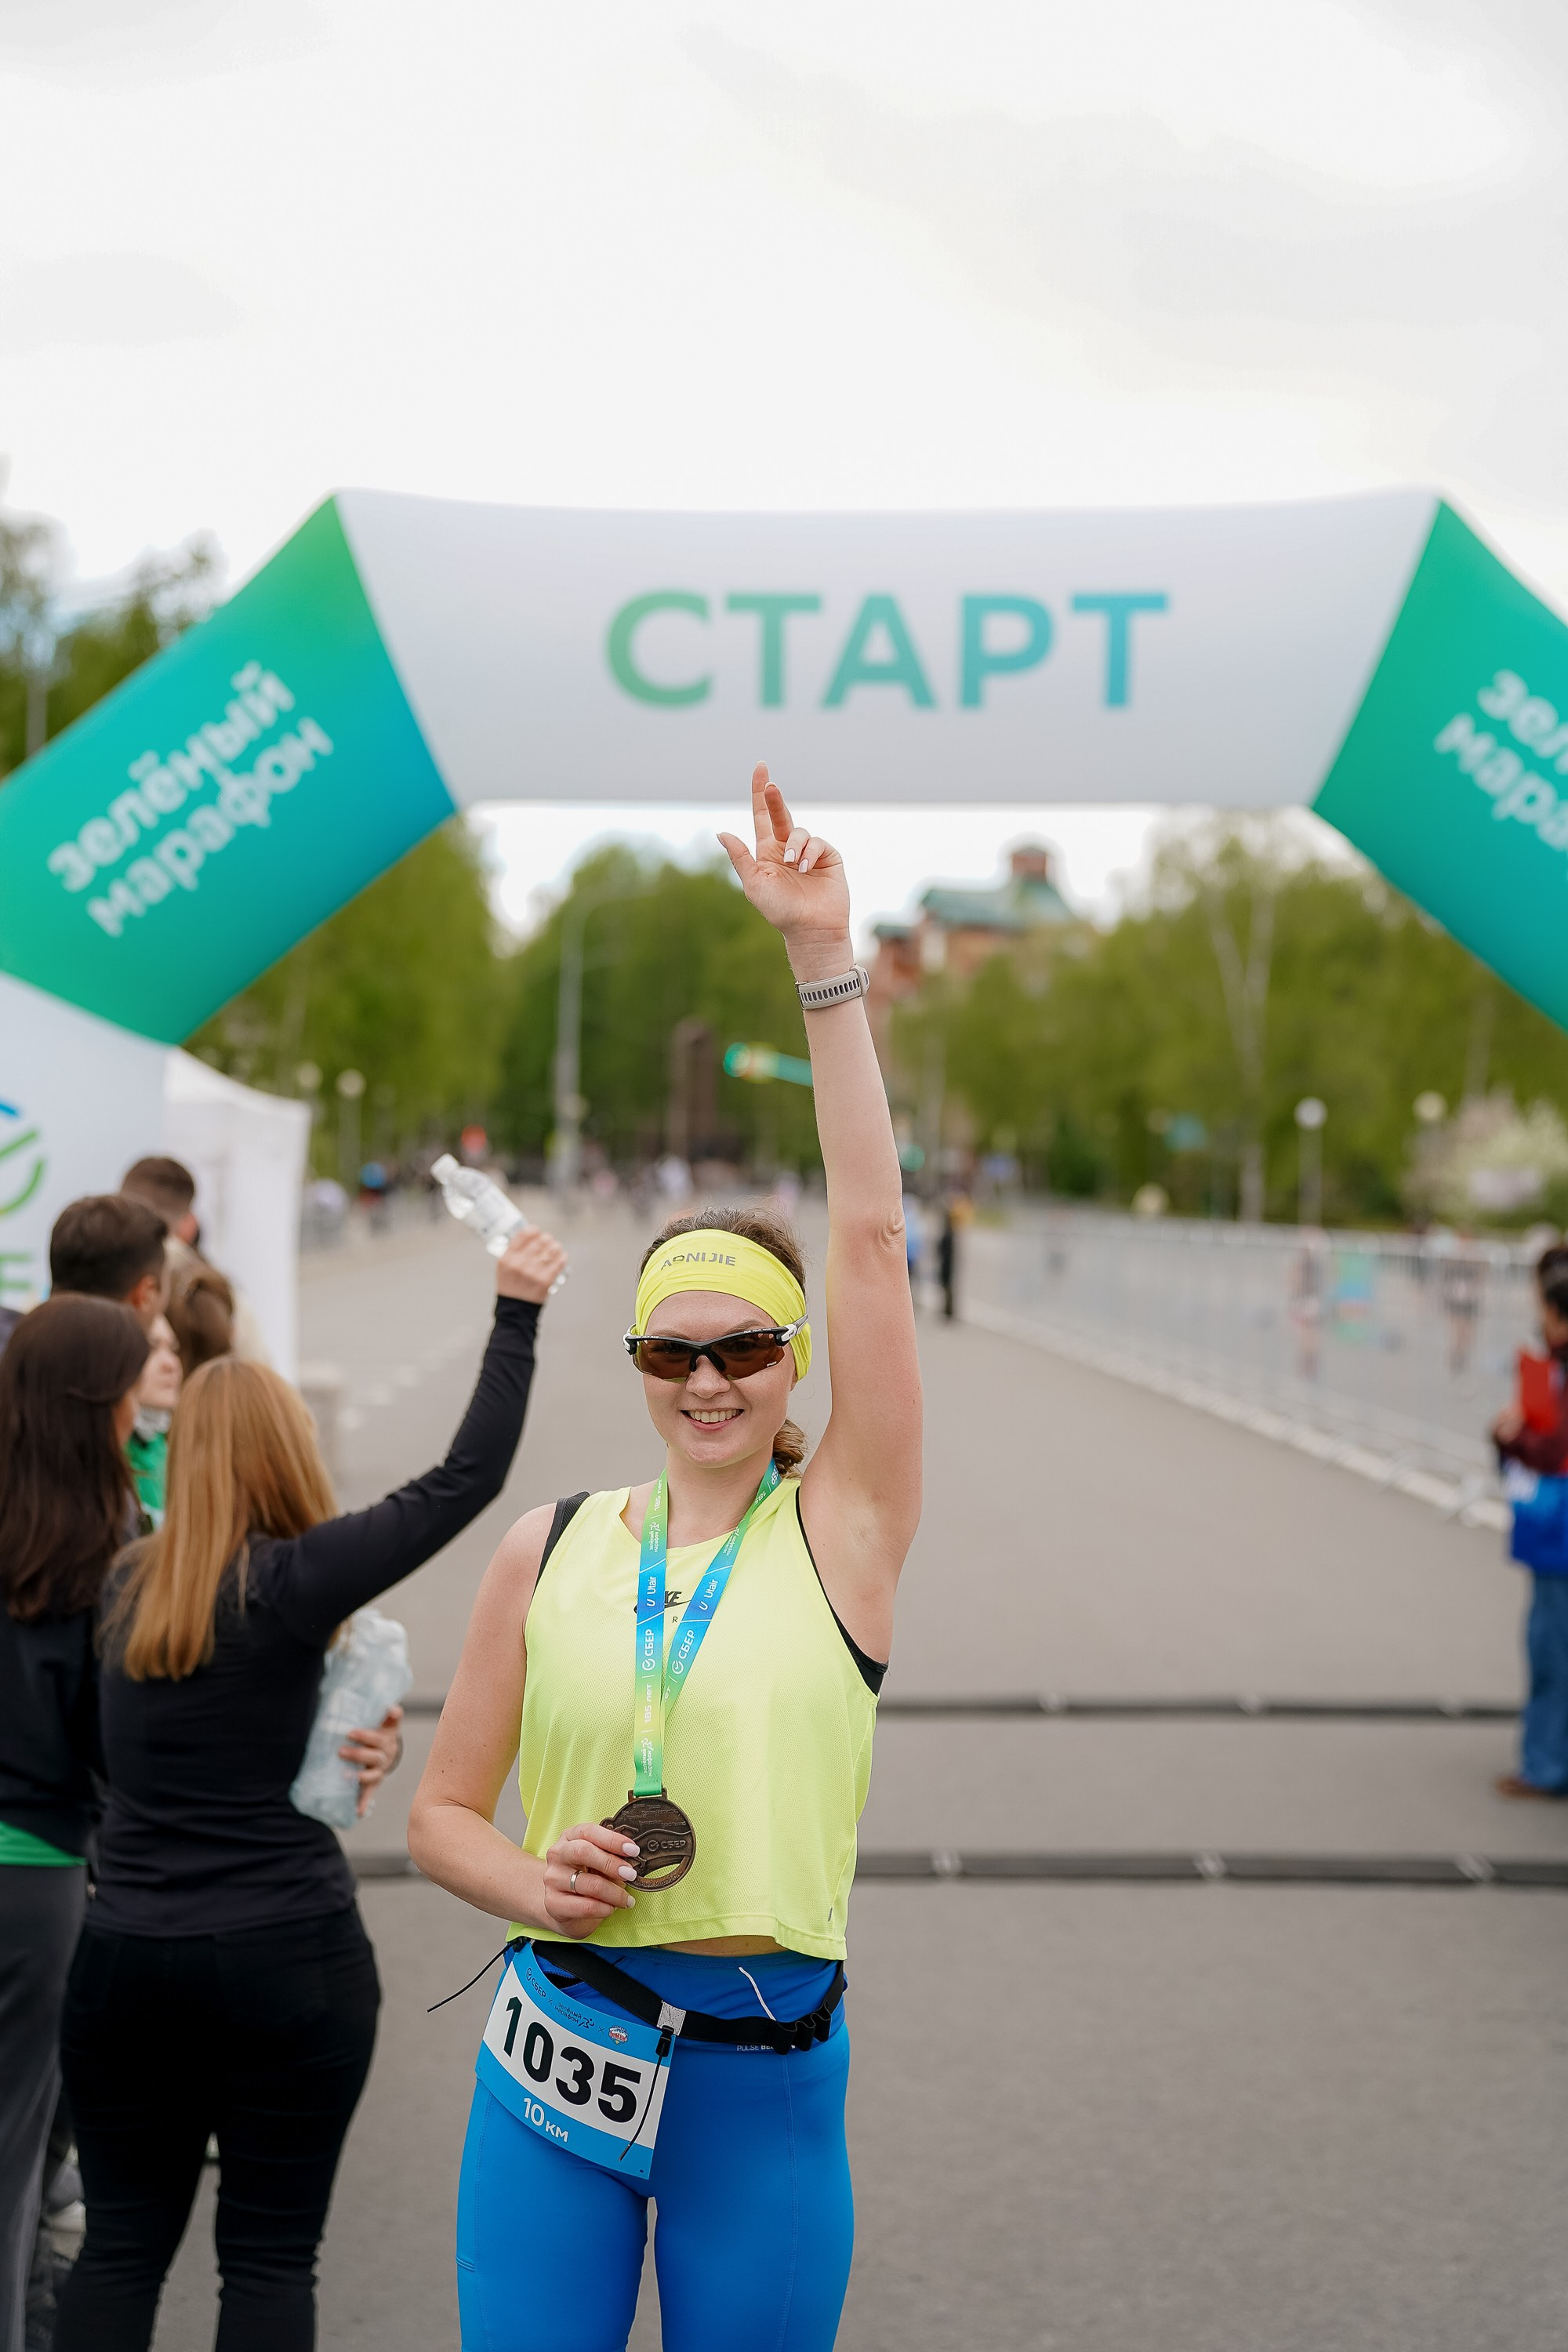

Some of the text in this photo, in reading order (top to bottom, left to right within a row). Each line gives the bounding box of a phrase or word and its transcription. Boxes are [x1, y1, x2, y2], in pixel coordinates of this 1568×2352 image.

[603, 589, 1170, 711] СТАРТ
[1432, 711, 1568, 855] мара
[86, 717, 334, 938] марафон
[771, 1465, 779, 1485] БЕР
[647, 1576, 657, 1595] Utair
[703, 1579, 719, 1599] Utair
[644, 1628, 655, 1657] СБЕР
[678, 1629, 696, 1660] СБЕР
[531, 1977, 546, 1998] СБЕР
[503, 1996, 642, 2123] 1035
[523, 2097, 545, 2127] 10
